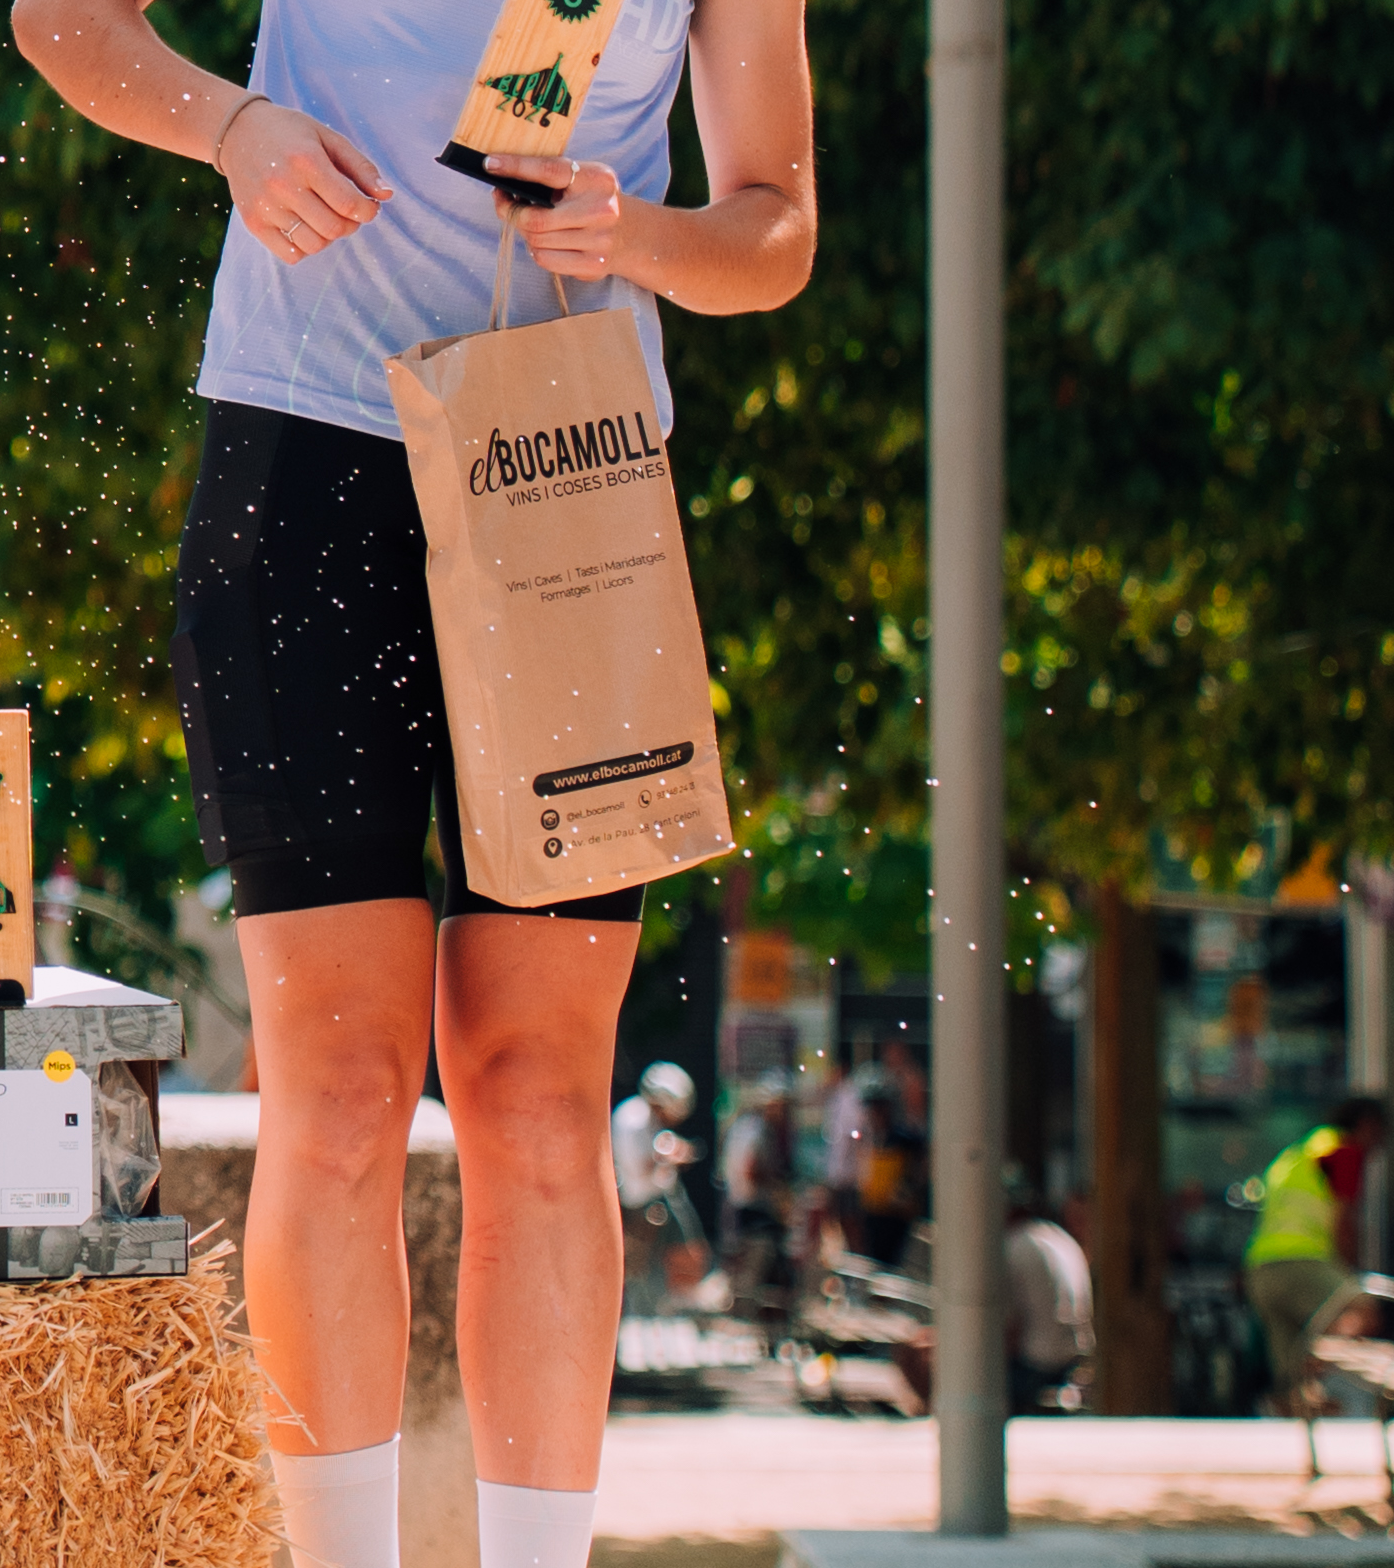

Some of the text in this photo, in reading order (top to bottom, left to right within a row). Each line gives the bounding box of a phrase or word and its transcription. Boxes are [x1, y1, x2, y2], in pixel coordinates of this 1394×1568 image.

[506, 488, 542, 507] VINS
[553, 475, 603, 498] COSES
[606, 462, 666, 486] BONES
[534, 573, 563, 588] Caves
[575, 566, 600, 579] Tasts
[604, 552, 667, 573] Maridatges
[540, 575, 634, 603] Formatges Licors
[552, 749, 682, 789] www.elbocamoll.cat
[588, 834, 601, 845] de
[673, 808, 701, 824] Celoni
[48, 1061, 72, 1073] Mips
